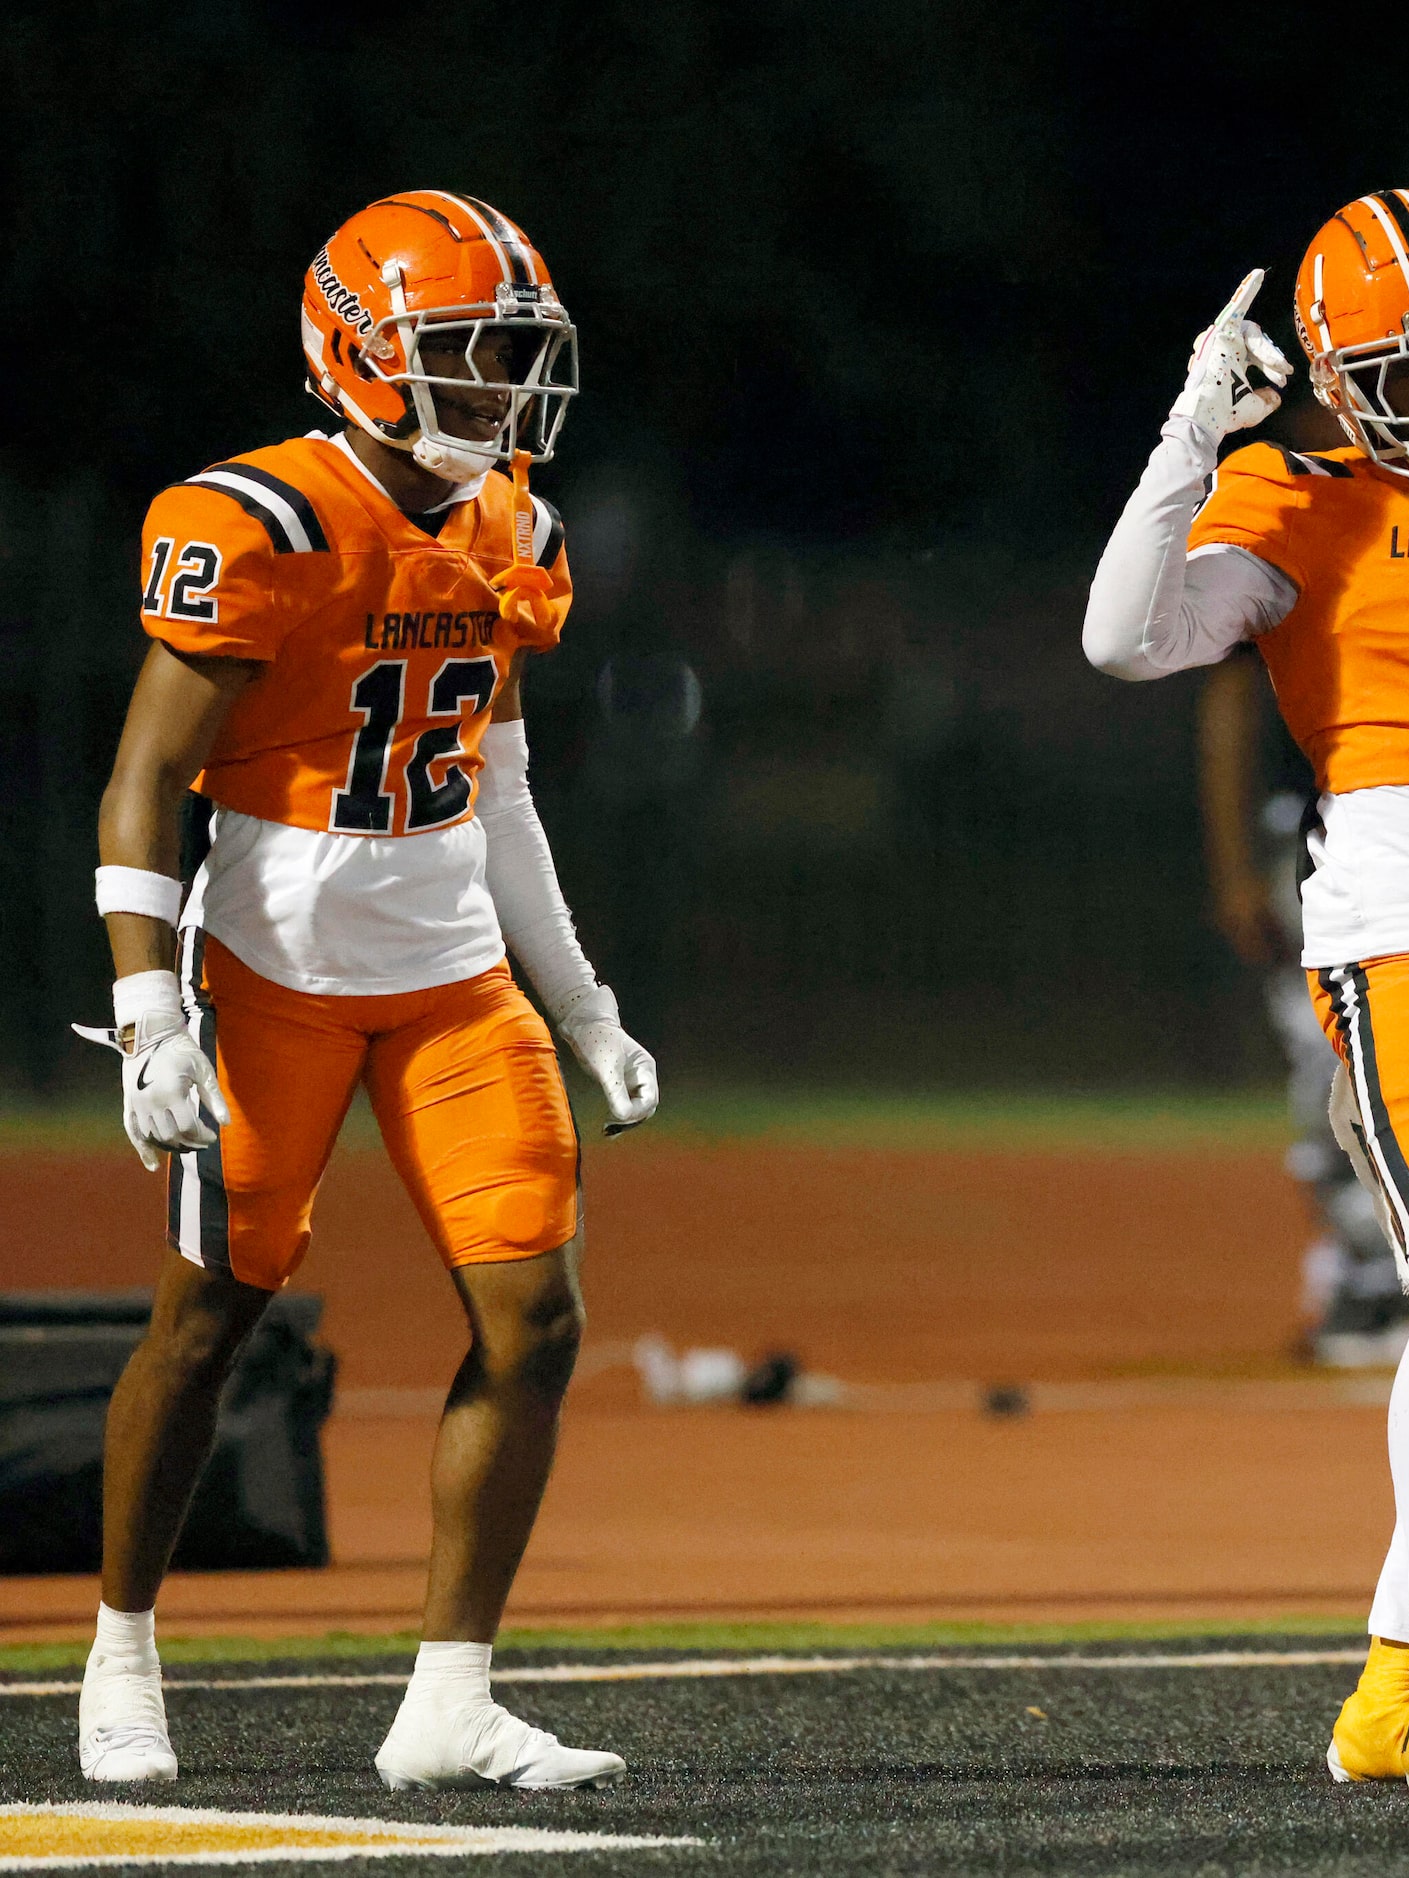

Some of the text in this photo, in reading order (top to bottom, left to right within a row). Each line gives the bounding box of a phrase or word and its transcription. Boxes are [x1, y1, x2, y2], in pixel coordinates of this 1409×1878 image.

[515, 510, 533, 558] NXTRND
[142, 535, 223, 625] 12
[328, 655, 500, 836] 12
